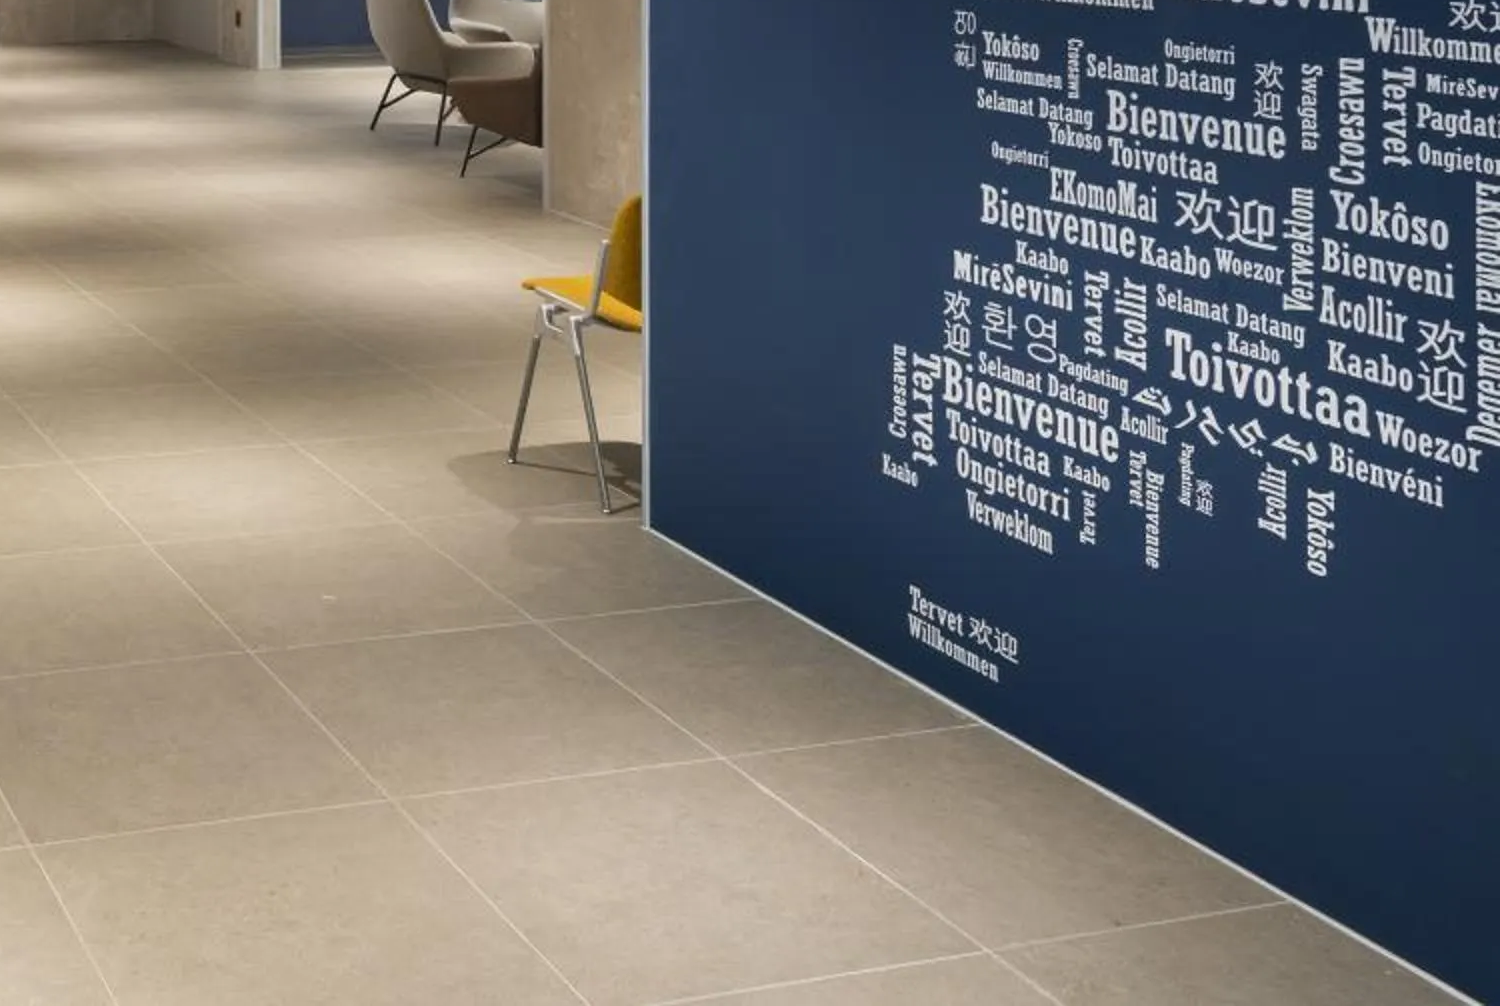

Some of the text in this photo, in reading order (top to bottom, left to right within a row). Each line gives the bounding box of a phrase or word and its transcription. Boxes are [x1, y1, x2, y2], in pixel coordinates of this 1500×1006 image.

[982, 30, 1040, 61] Yokôso
[982, 60, 1062, 90] Willkommen
[1164, 38, 1235, 65] Ongietorri
[1086, 53, 1236, 101] Selamat Datang
[1297, 63, 1323, 151] Swagata
[977, 86, 1094, 131] Selamat Datang
[1106, 89, 1286, 159] Bienvenue
[1382, 65, 1416, 167] Tervet
[991, 140, 1049, 169] Ongietorri
[1107, 135, 1219, 185] Toivottaa
[980, 183, 1136, 259] Bienvenue
[1050, 166, 1158, 223] EKomoMai
[1174, 188, 1277, 250] 欢迎
[1329, 189, 1449, 251] Yokôso
[1015, 239, 1069, 275] Kaabo
[1139, 235, 1284, 286] Kaabo Woezor
[1283, 187, 1315, 312] Verweklom
[1321, 237, 1455, 299] Bienveni
[981, 301, 1057, 363] 환영
[1083, 269, 1110, 358] Tervet
[1114, 277, 1147, 372] Acollir
[1156, 283, 1306, 348] Selamat Datang
[1319, 285, 1409, 343] Acollir
[1058, 353, 1129, 397] Pagdating
[1227, 331, 1281, 365] Kaabo
[1327, 339, 1413, 392] Kaabo
[1416, 319, 1467, 413] 欢迎
[912, 352, 943, 467] Tervet
[941, 356, 1120, 463] Bienvenue
[978, 350, 1110, 421] Selamat Datang
[1165, 327, 1371, 439] Toivottaa
[945, 407, 1051, 478] Toivottaa
[1120, 405, 1169, 446] Acollir
[1375, 408, 1483, 474] Woezor
[881, 451, 918, 488] Kaabo
[956, 446, 1070, 522] Ongietorri
[1062, 455, 1111, 492] Kaabo
[1129, 449, 1147, 508] Tervet
[1329, 441, 1444, 508] Bienvéni
[966, 488, 1053, 555] Verweklom
[1079, 490, 1097, 546] Tervet
[1145, 467, 1165, 570] Bienvenue
[1258, 461, 1287, 541] Acollir
[908, 613, 999, 683] Willkommen
[909, 583, 1019, 665] Tervet 欢迎
